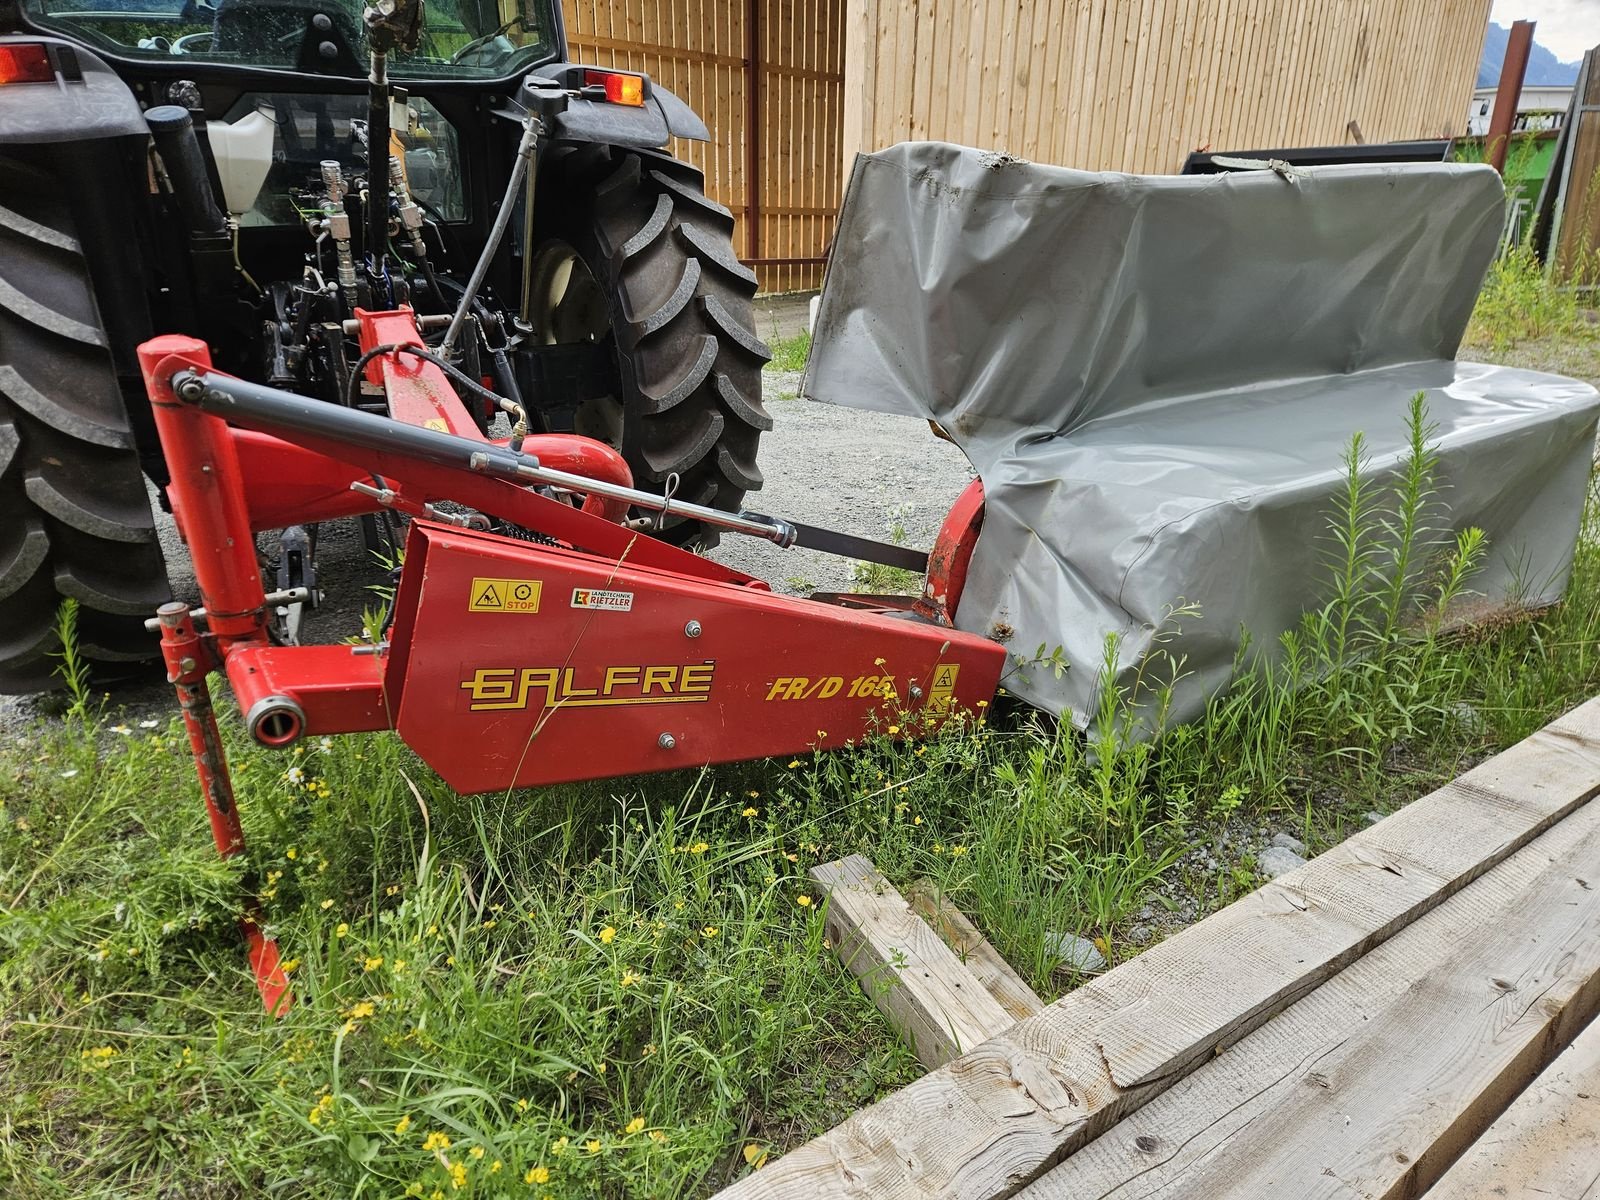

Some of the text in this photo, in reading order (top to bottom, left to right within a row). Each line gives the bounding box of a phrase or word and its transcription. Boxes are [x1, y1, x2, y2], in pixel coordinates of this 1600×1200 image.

[591, 591, 631, 599] LANDTECHNIK
[507, 601, 534, 609] STOP
[590, 597, 630, 607] RIETZLER
[765, 677, 844, 701] FR/D
